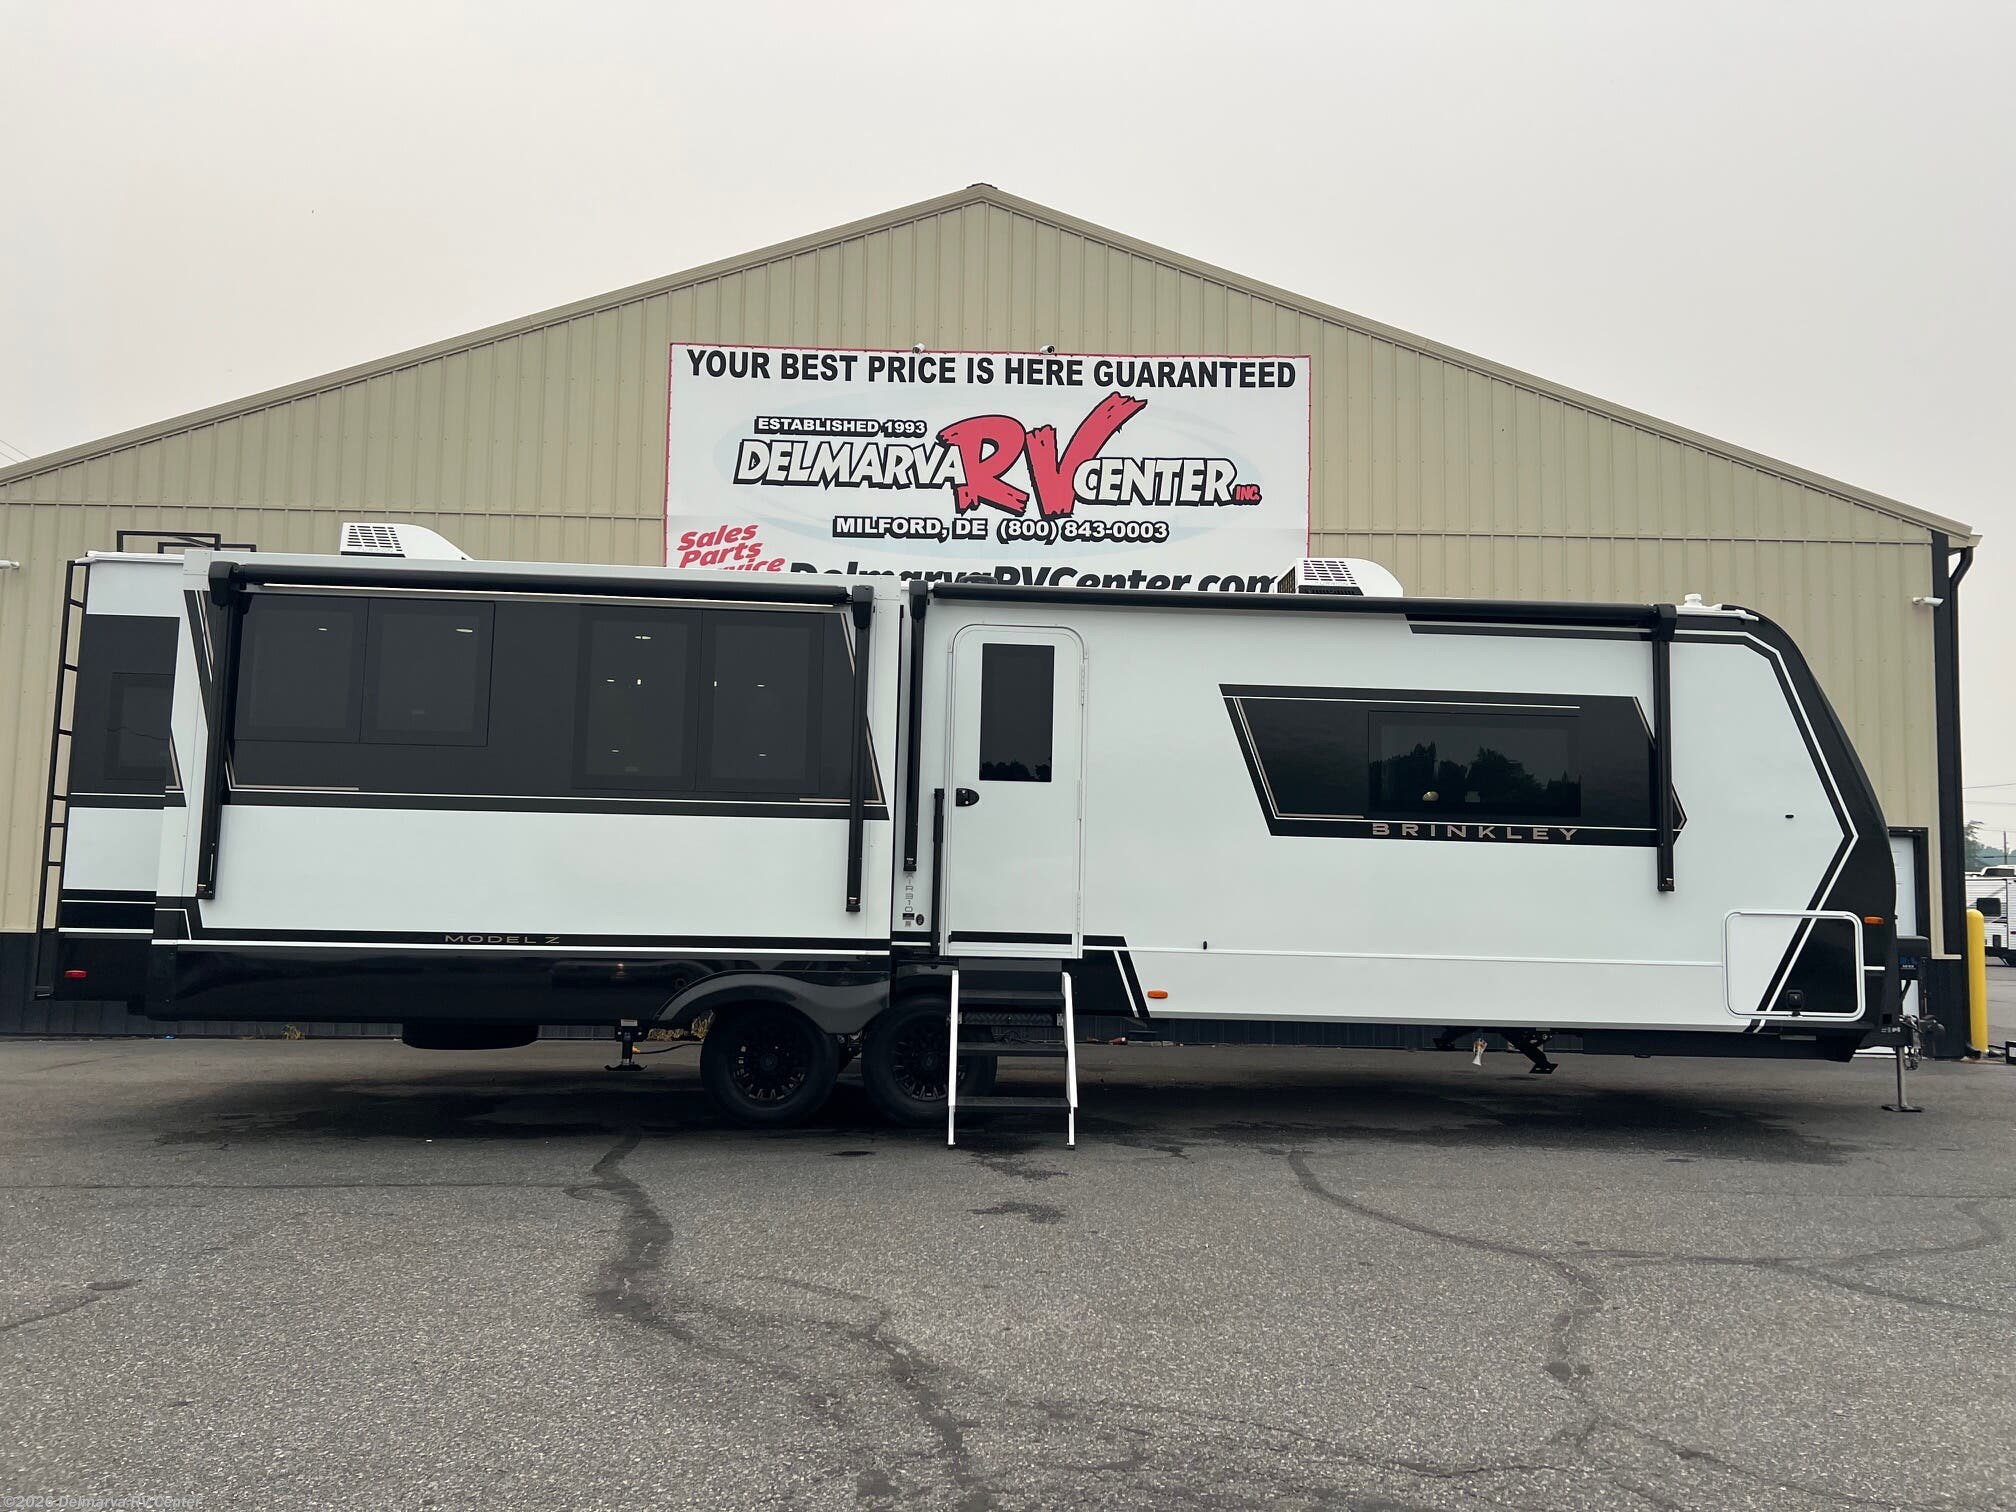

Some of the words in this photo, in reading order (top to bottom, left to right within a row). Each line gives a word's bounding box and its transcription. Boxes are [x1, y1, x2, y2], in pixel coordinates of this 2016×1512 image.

[686, 349, 770, 379] YOUR
[781, 352, 858, 382] BEST
[868, 355, 956, 383] PRICE
[967, 357, 994, 384] IS
[1004, 357, 1083, 386] HERE
[1093, 360, 1296, 388] GUARANTEED
[757, 417, 880, 434] ESTABLISHED
[884, 420, 927, 434] 1993
[734, 439, 968, 489] DELMARVA
[936, 391, 1148, 519] RV
[1073, 457, 1237, 506] CENTER
[677, 524, 760, 551] Sales
[835, 516, 950, 538] MILFORD,
[955, 519, 987, 535] DE
[1000, 520, 1058, 541] (800)
[1063, 520, 1169, 539] 843-0003
[679, 542, 763, 568] Parts
[1372, 822, 1579, 841] BRINKLEY
[444, 934, 537, 944] MODEL
[544, 936, 560, 944] Z
